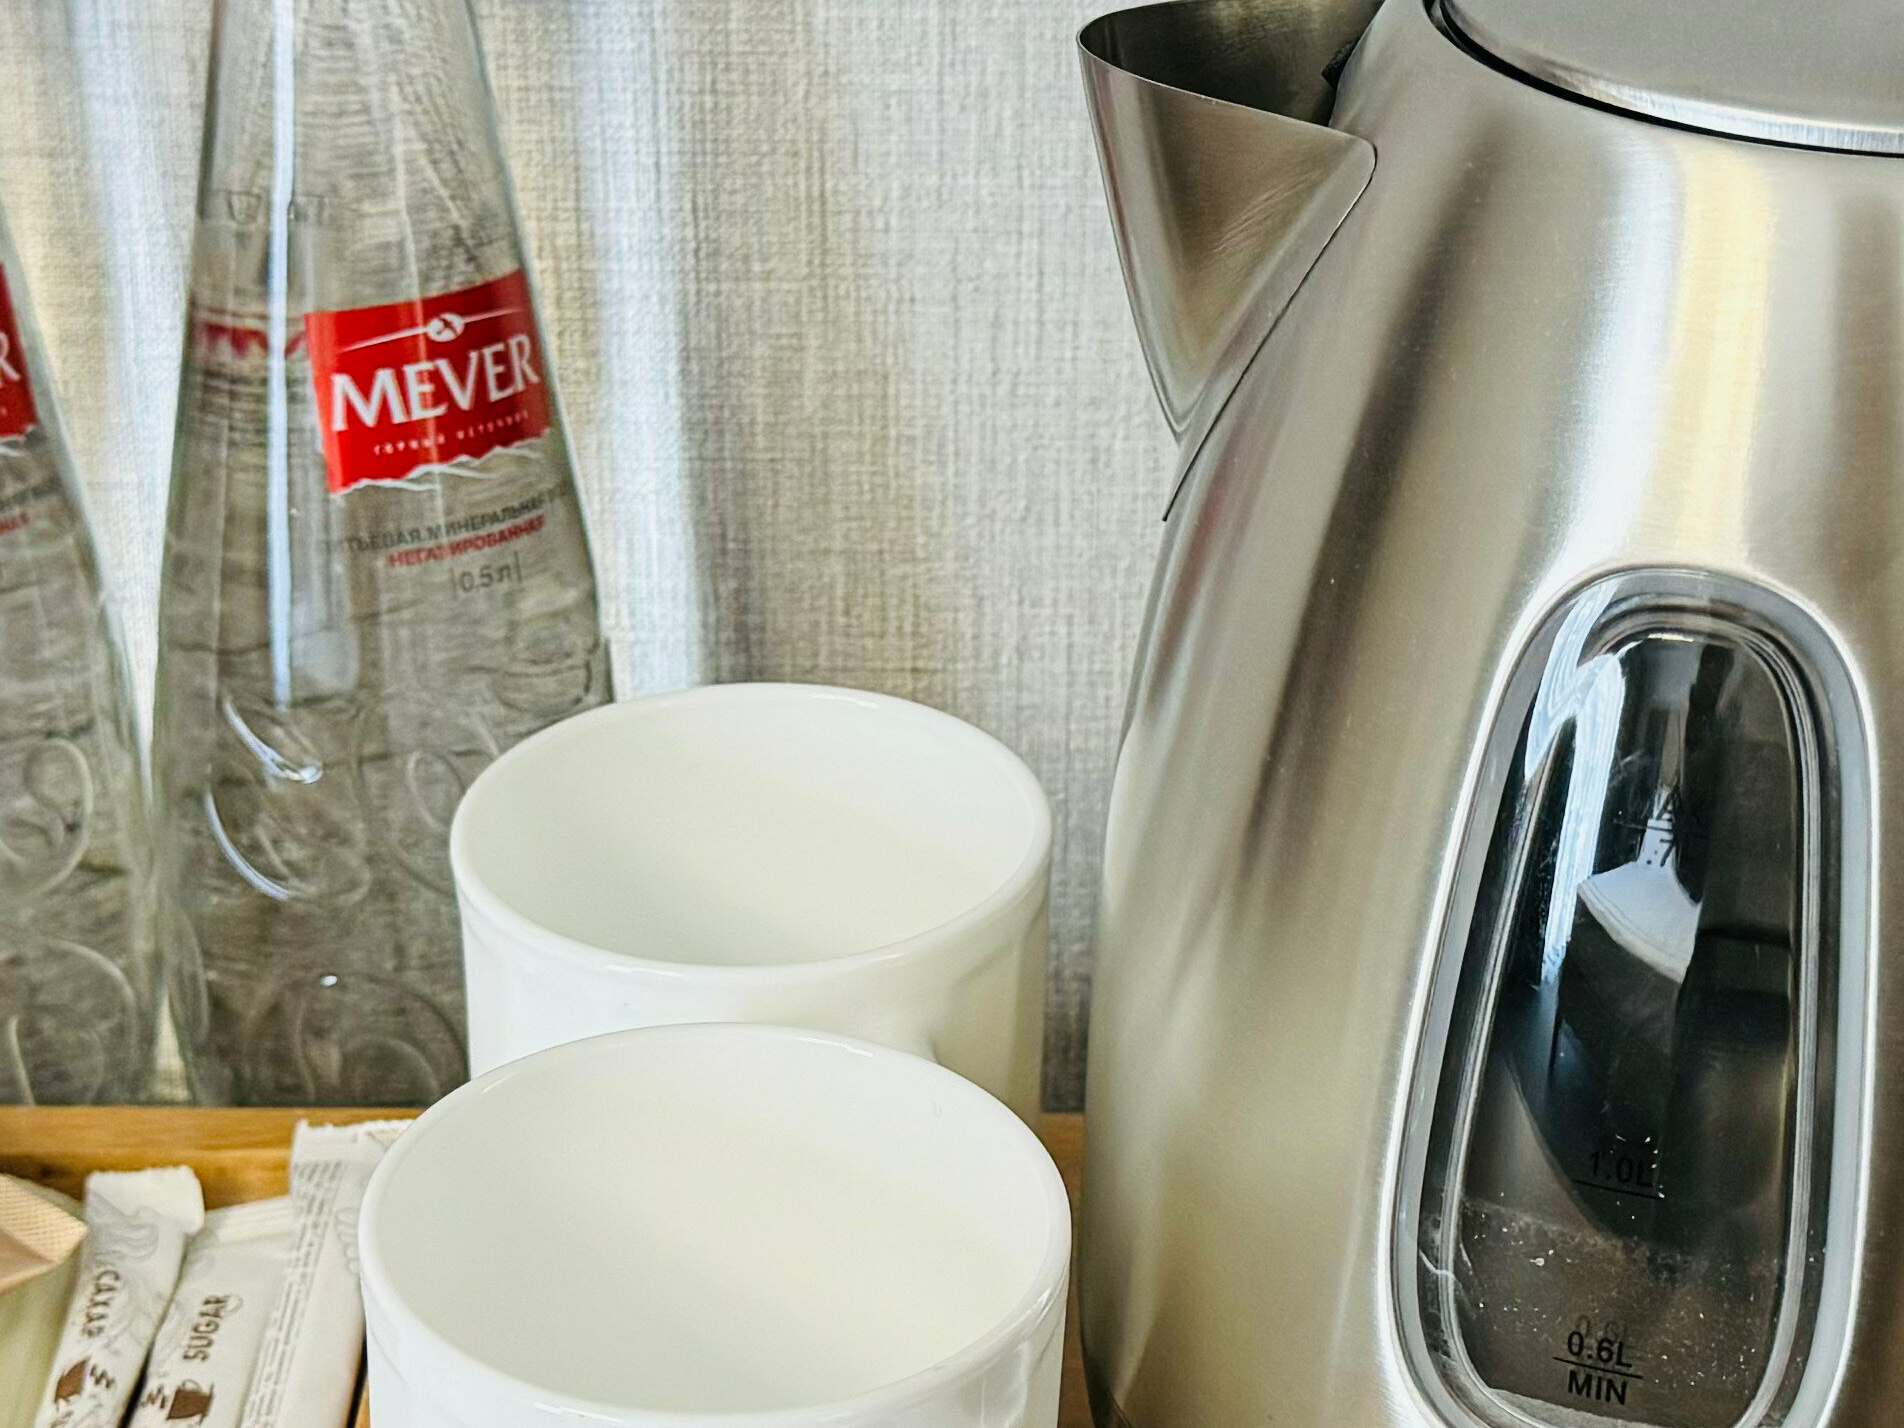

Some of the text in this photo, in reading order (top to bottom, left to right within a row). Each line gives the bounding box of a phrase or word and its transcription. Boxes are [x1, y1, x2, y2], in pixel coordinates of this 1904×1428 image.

[330, 333, 540, 432] MEVER
[183, 1292, 233, 1363] SUGAR
[1567, 1330, 1633, 1368] 0.6L
[1568, 1369, 1628, 1406] MIN
